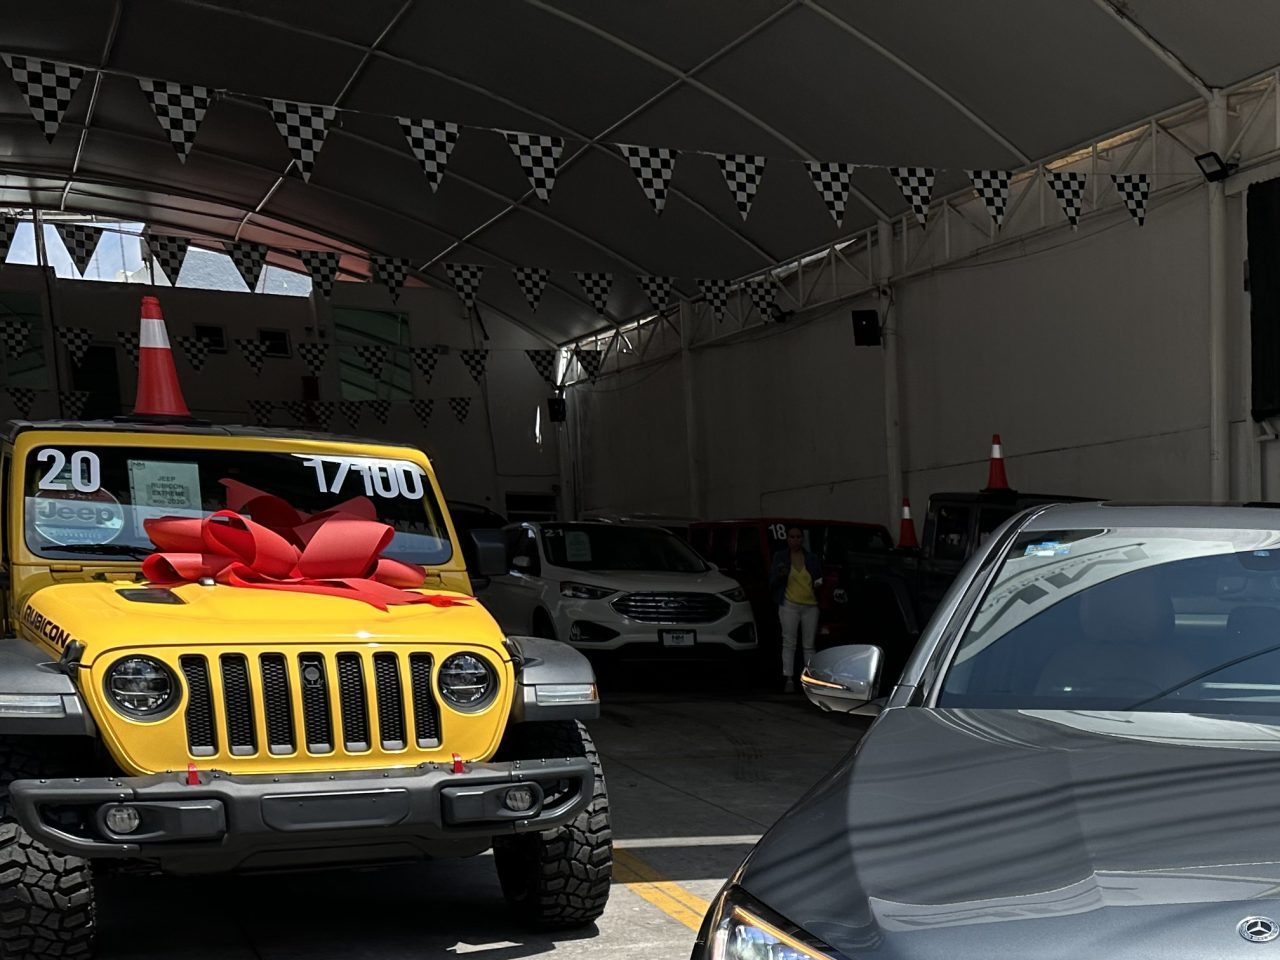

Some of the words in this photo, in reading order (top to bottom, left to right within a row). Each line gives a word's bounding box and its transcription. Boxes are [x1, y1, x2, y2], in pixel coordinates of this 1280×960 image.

[37, 449, 100, 493] 20
[38, 501, 114, 525] Jeep
[544, 528, 564, 537] 21
[768, 523, 787, 540] 18
[24, 604, 71, 649] RUBICON
